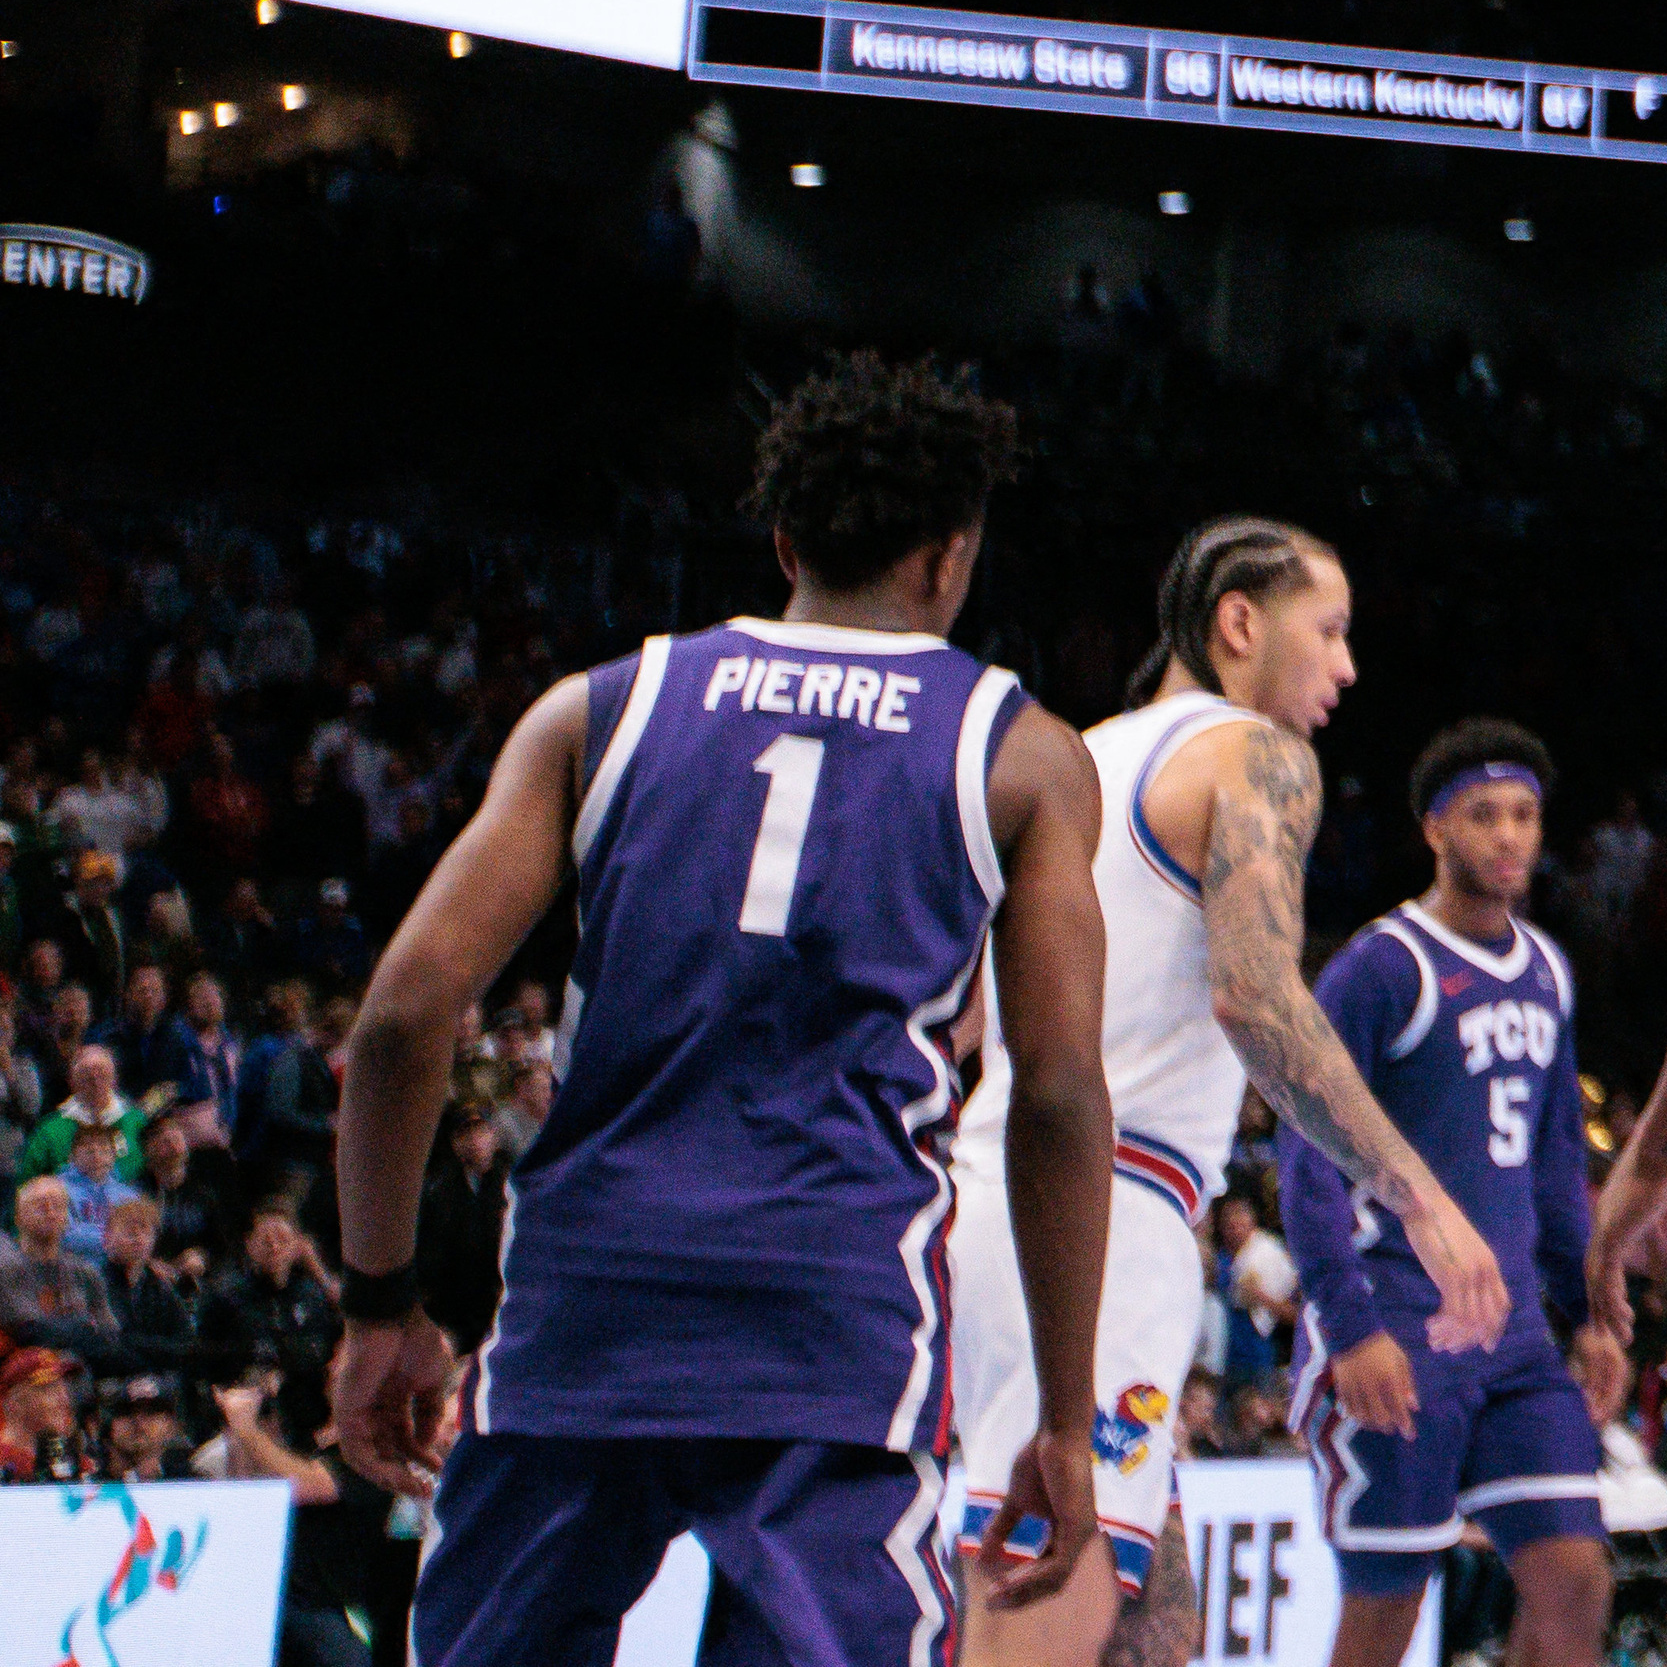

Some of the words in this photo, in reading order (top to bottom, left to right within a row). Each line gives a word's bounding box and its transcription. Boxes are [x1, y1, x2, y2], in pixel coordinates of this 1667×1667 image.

[851, 21, 1029, 82] Kennesaw
[1032, 37, 1130, 91] State
[1230, 55, 1373, 113] Western
[1373, 68, 1523, 131] Kentucky
[0, 238, 133, 300] ENTER
[702, 654, 923, 734] PIERRE
[738, 733, 826, 938] 1
[1457, 999, 1559, 1076] TCU
[1486, 1075, 1531, 1169] 5
